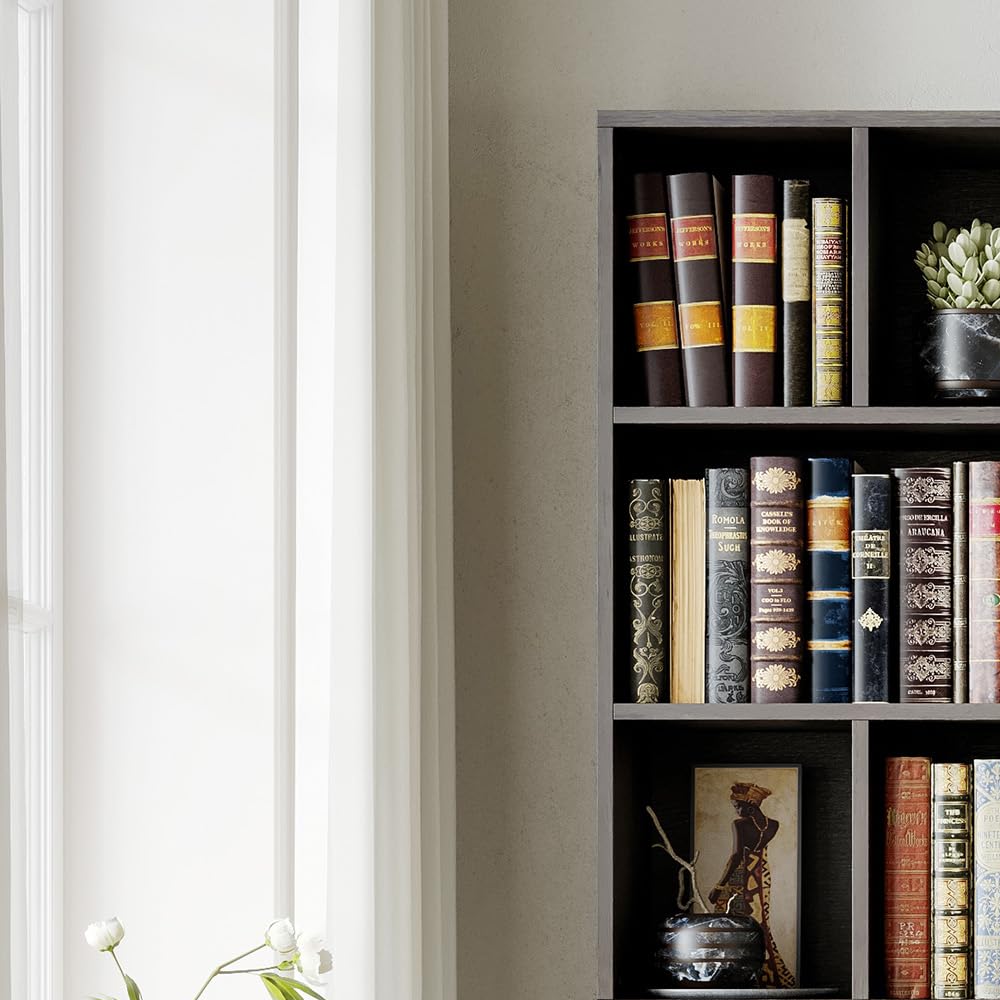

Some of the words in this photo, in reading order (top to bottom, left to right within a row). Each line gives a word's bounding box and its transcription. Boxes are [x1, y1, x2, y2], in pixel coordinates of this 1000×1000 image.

[632, 240, 664, 248] WORKS
[711, 514, 745, 525] ROMOLA
[907, 528, 945, 537] ARAUCANA
[718, 541, 741, 552] SUCH
